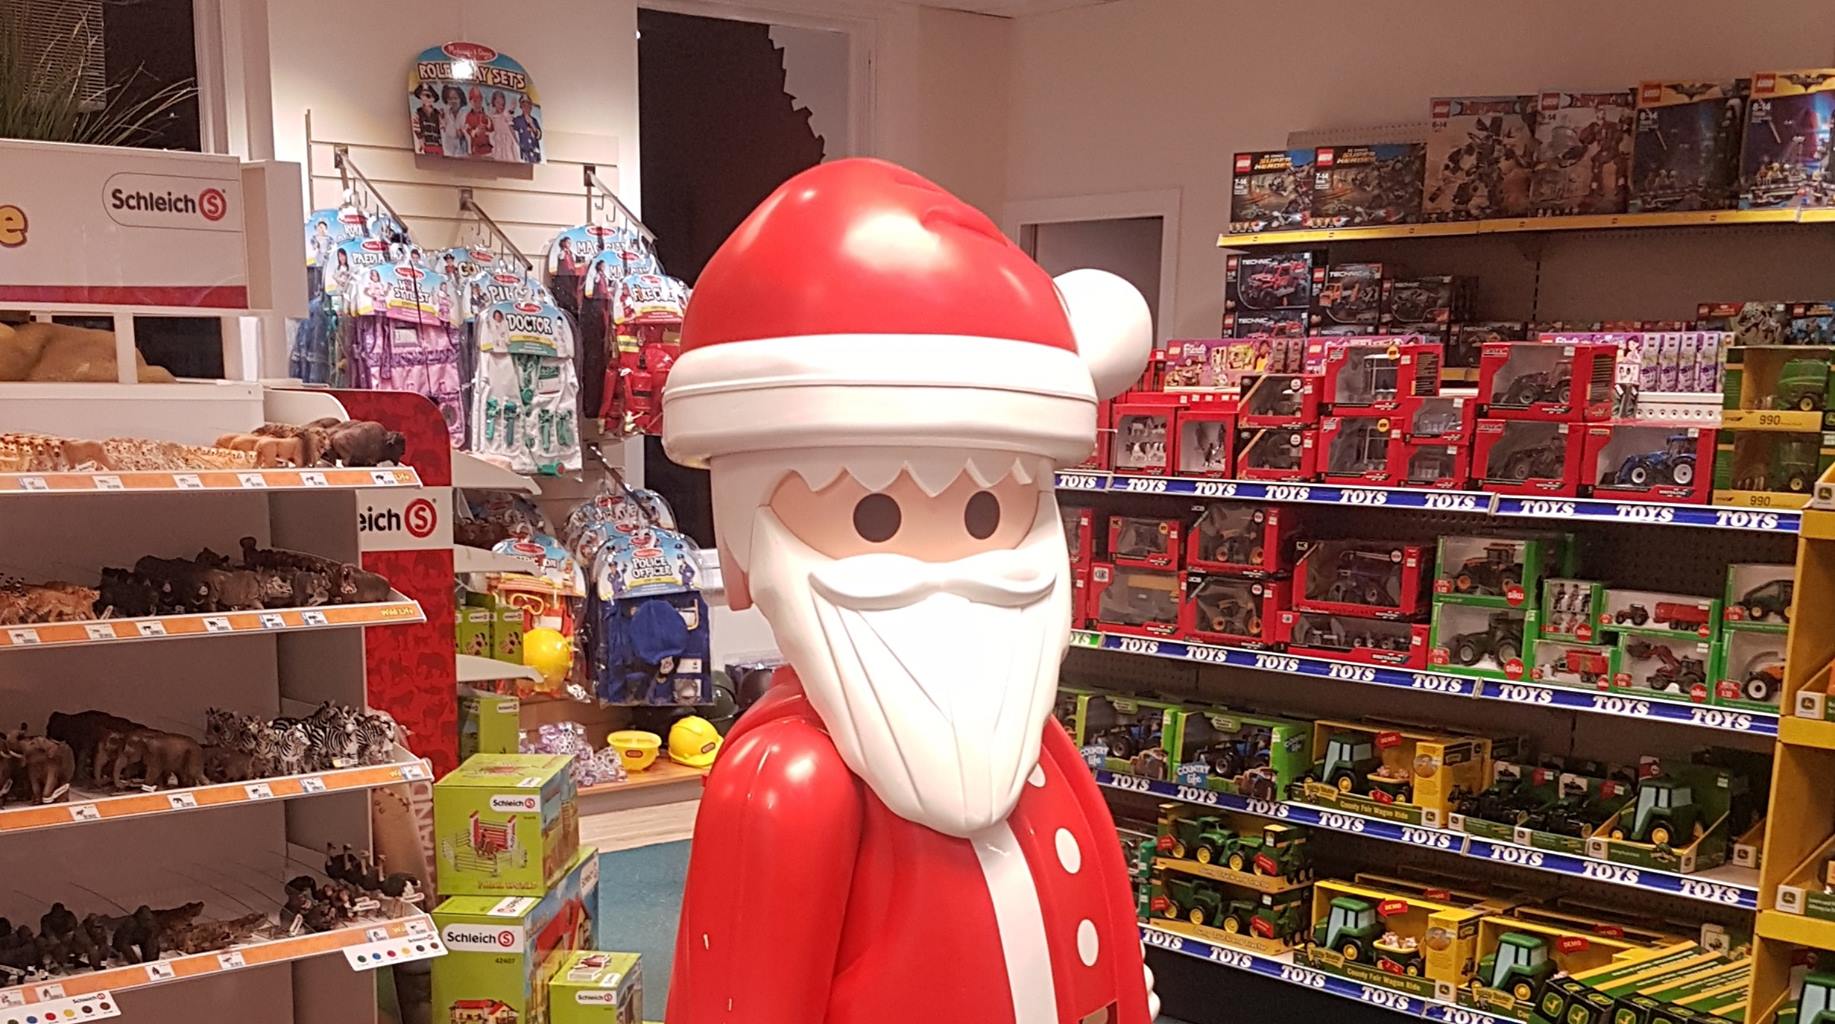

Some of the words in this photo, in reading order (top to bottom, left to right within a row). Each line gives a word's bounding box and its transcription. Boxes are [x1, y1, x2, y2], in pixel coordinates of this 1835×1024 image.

[418, 63, 451, 80] ROLE
[492, 67, 525, 89] SETS
[111, 188, 196, 215] Schleich
[506, 313, 553, 335] DOCTOR
[1759, 415, 1781, 426] 990
[1059, 475, 1098, 489] TOYS
[1127, 478, 1167, 492] TOYS
[1195, 482, 1237, 496] TOYS
[1264, 485, 1311, 500] TOYS
[1339, 490, 1388, 505] TOYS
[1425, 493, 1476, 509] TOYS
[1750, 495, 1771, 507] 990
[1520, 499, 1576, 516] TOYS
[1615, 504, 1675, 522] TOYS
[1716, 510, 1780, 529] TOYS
[632, 558, 668, 569] POLICE
[1120, 638, 1159, 654] TOYS
[1186, 645, 1227, 662] TOYS
[1255, 655, 1299, 672] TOYS
[1329, 663, 1376, 681] TOYS
[1412, 674, 1463, 693] TOYS
[1499, 684, 1553, 705] TOYS
[1593, 696, 1650, 717] TOYS
[1690, 708, 1752, 731] TOYS
[1112, 773, 1150, 791] TOYS
[493, 799, 524, 808] Schleich
[1178, 785, 1218, 804] TOYS
[1246, 798, 1290, 818] TOYS
[1318, 812, 1365, 832] TOYS
[1402, 827, 1450, 848] TOYS
[1491, 844, 1543, 868] TOYS
[1583, 861, 1640, 884] TOYS
[1680, 878, 1740, 904] TOYS
[447, 931, 496, 945] Schleich
[1143, 928, 1183, 950] TOYS
[1209, 946, 1253, 968] TOYS
[1280, 965, 1326, 988] TOYS
[1361, 986, 1409, 1010] TOYS
